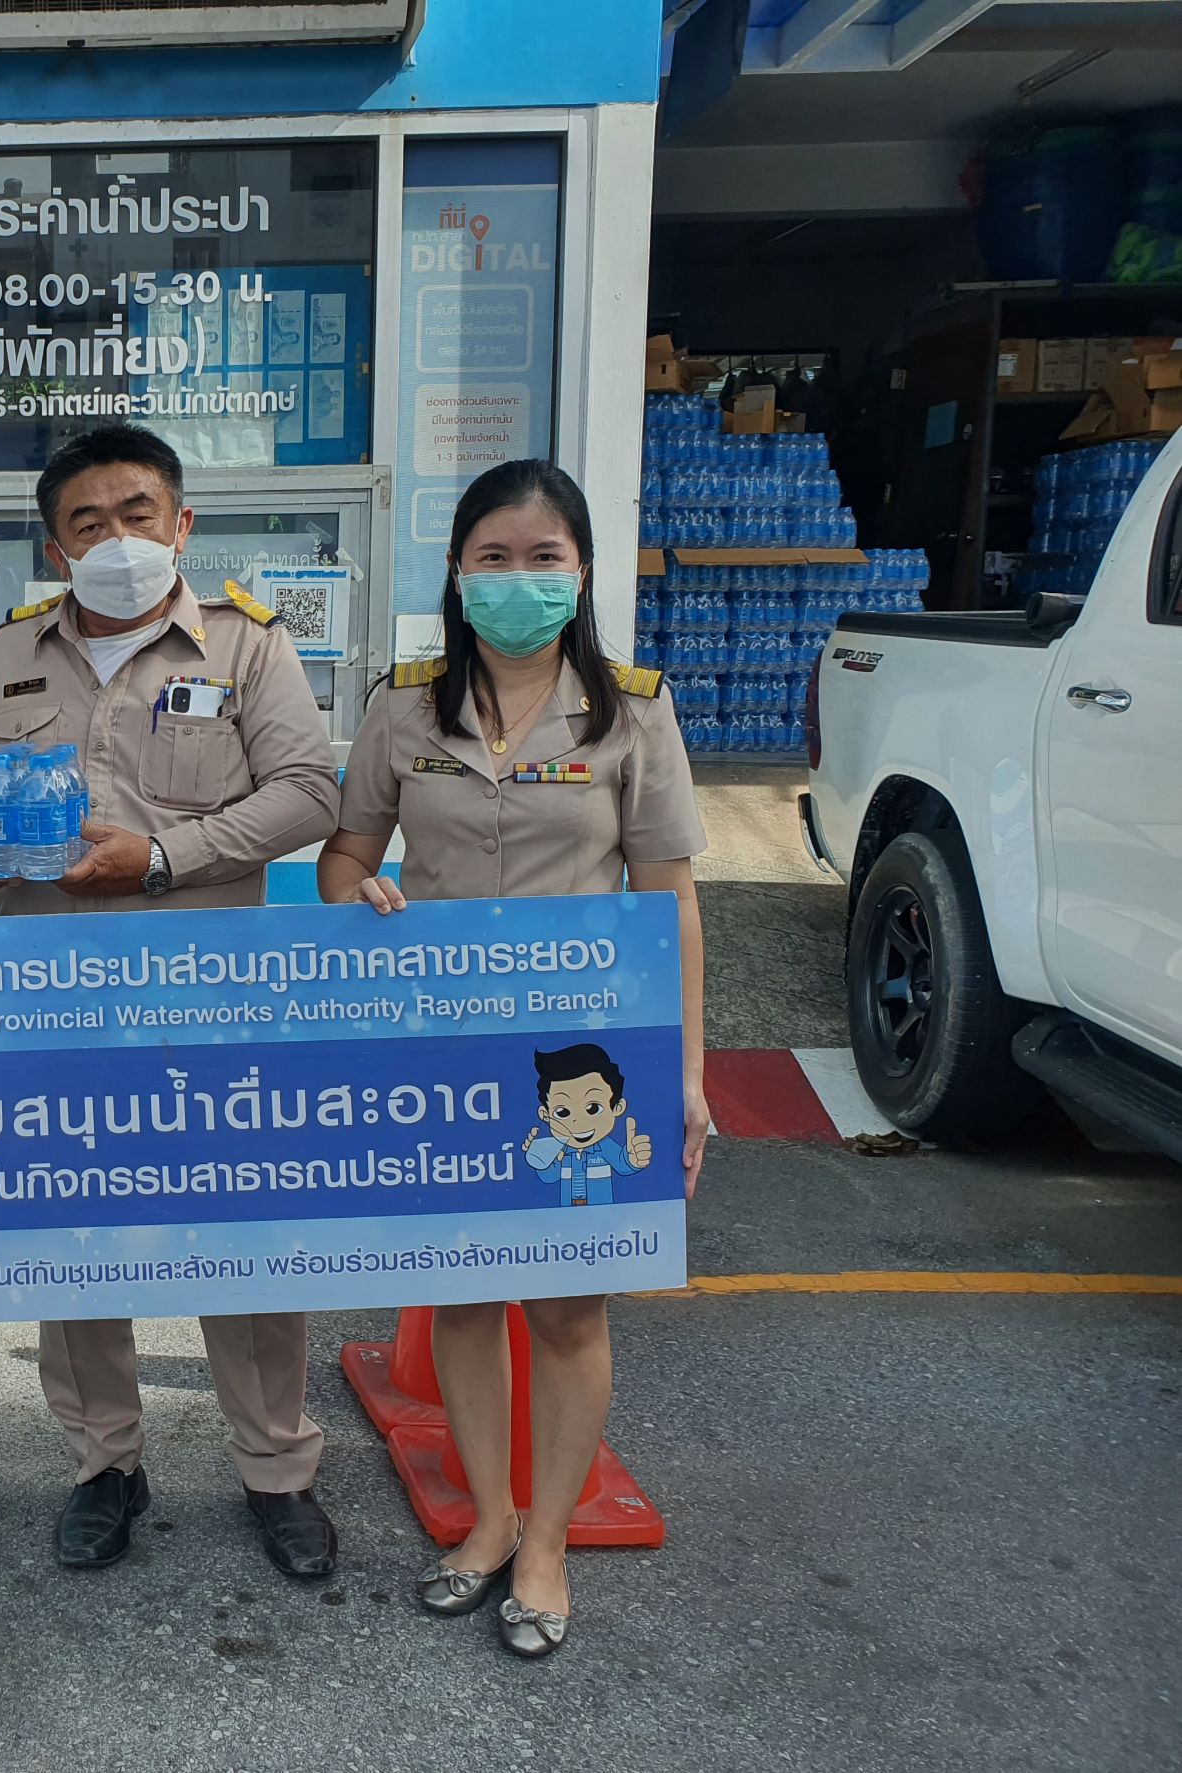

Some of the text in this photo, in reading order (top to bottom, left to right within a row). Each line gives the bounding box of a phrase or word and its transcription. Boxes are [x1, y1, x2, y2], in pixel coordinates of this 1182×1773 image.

[439, 203, 466, 229] ที่นี่
[411, 243, 551, 273] DIGITAL
[240, 272, 274, 303] น.
[436, 453, 453, 462] 1-3
[115, 1000, 273, 1027] Waterworks
[284, 997, 405, 1023] Authority
[416, 992, 516, 1020] Rayong
[527, 987, 619, 1013] Branch
[266, 1228, 660, 1278] พร้อมร่วมสร้างสังคมน่าอยู่ต่อไป
